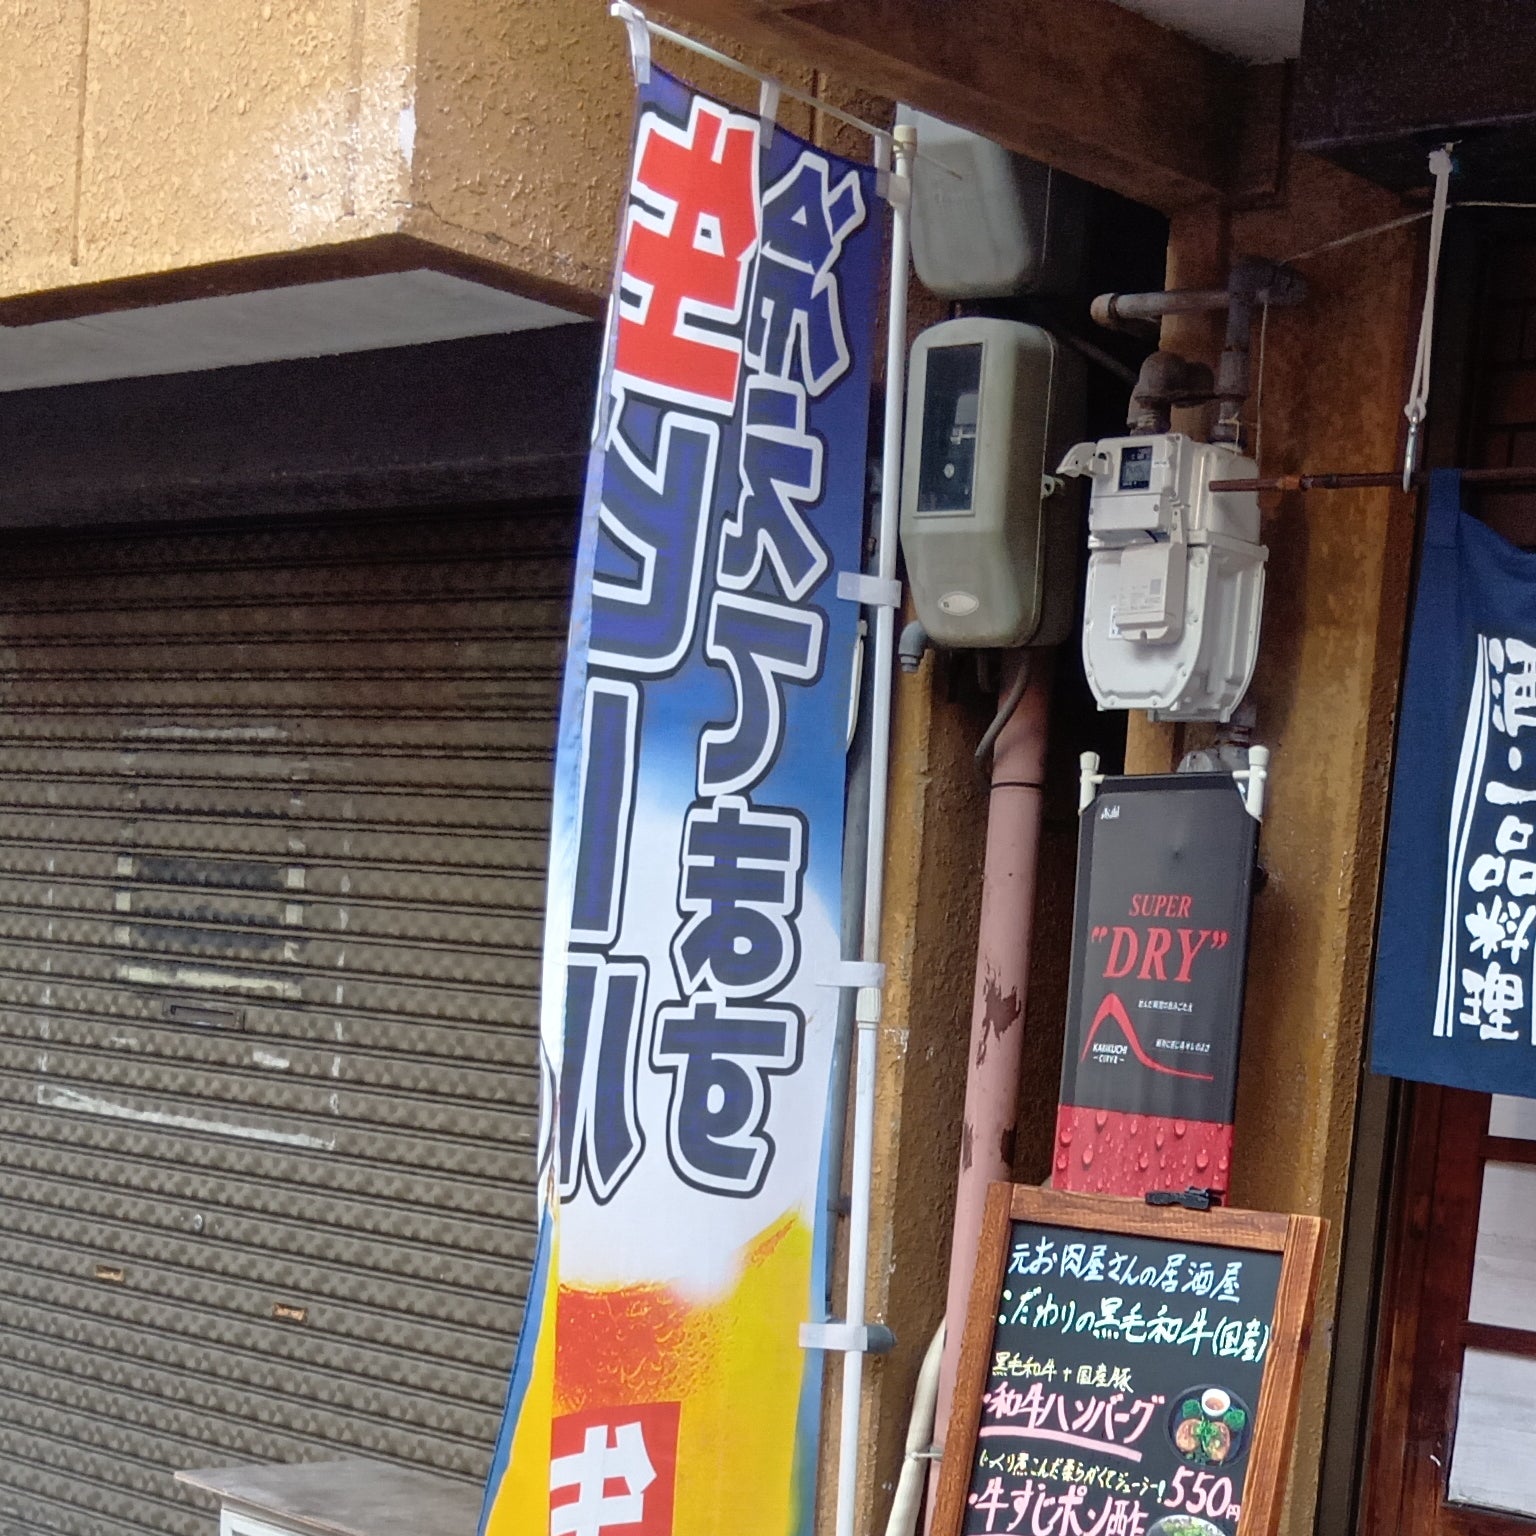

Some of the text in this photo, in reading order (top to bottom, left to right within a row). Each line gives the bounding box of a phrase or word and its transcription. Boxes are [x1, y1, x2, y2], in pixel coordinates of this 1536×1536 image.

[1128, 893, 1193, 918] SUPER
[1008, 1236, 1242, 1303] 元お肉屋さんの居酒屋
[1163, 1465, 1242, 1521] 550円
